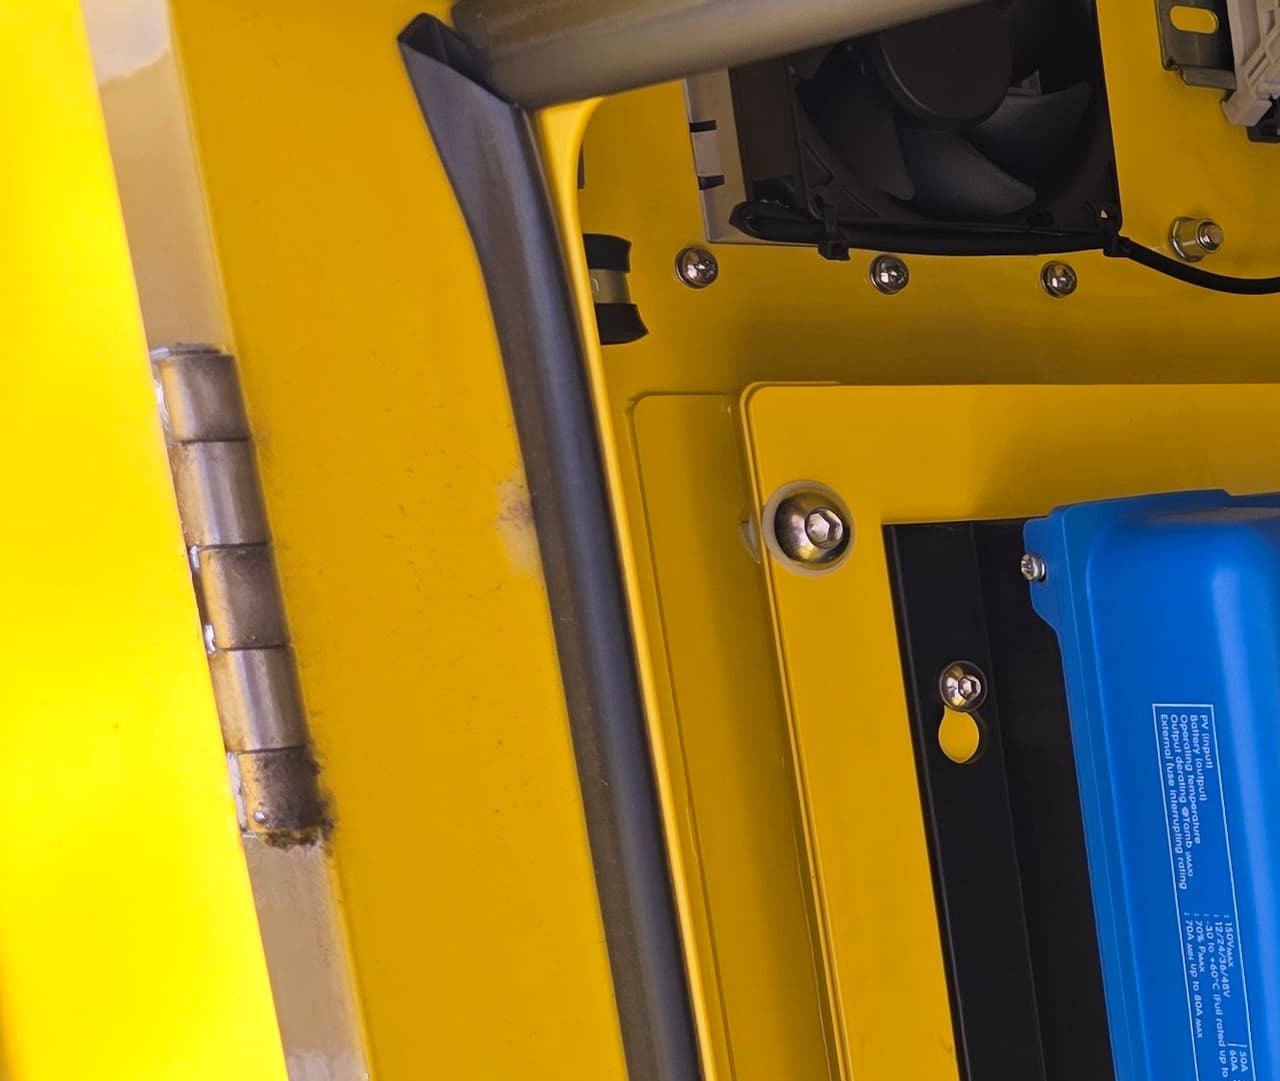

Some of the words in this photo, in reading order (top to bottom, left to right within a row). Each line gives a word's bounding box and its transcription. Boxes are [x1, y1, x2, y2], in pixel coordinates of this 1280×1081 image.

[1171, 714, 1181, 752] Output
[1176, 756, 1187, 803] derating
[1180, 714, 1193, 771] Operating
[1188, 774, 1201, 844] temperature
[1190, 714, 1201, 754] Battery
[1161, 714, 1173, 759] External
[1167, 762, 1175, 786] fuse
[1179, 857, 1188, 889] rating
